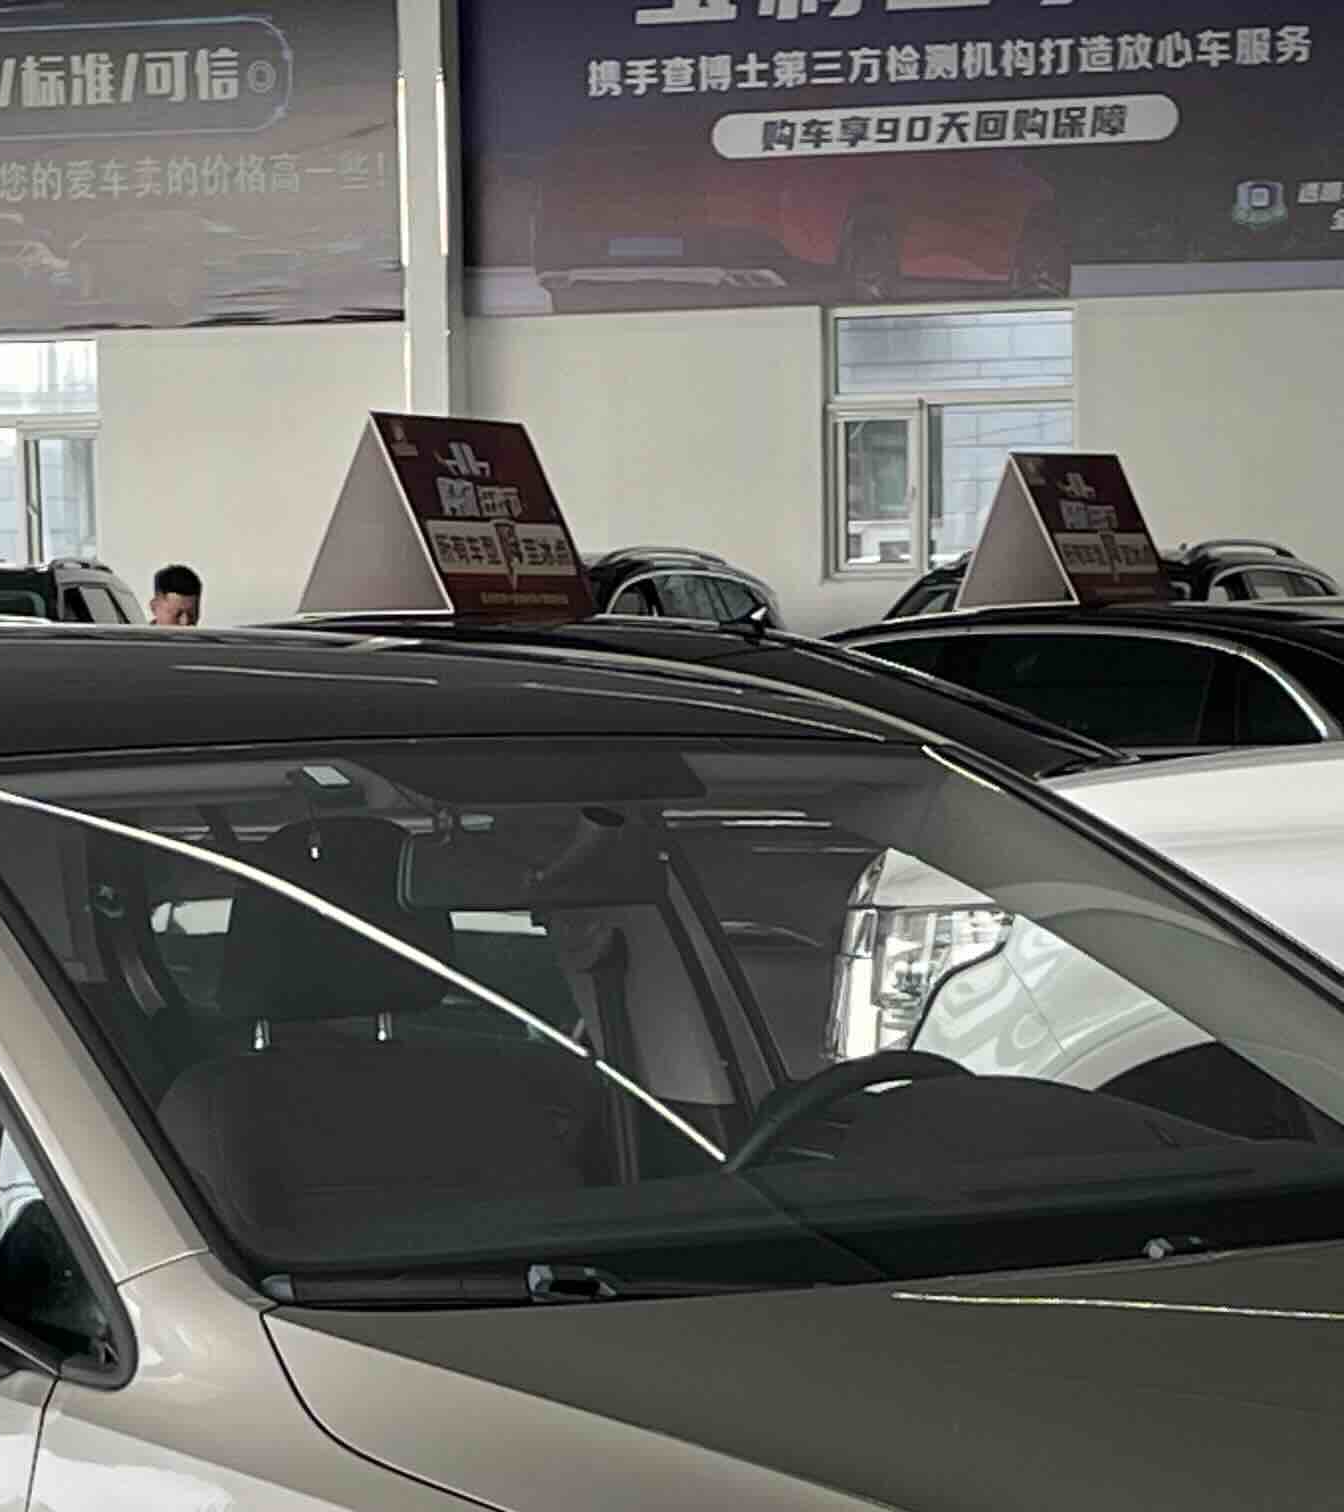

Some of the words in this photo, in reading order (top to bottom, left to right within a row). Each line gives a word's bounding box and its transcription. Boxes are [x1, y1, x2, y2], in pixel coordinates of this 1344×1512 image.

[587, 25, 1313, 97] 携手查博士第三方检测机构打造放心车服务
[762, 104, 1128, 152] 购车享90天回购保障
